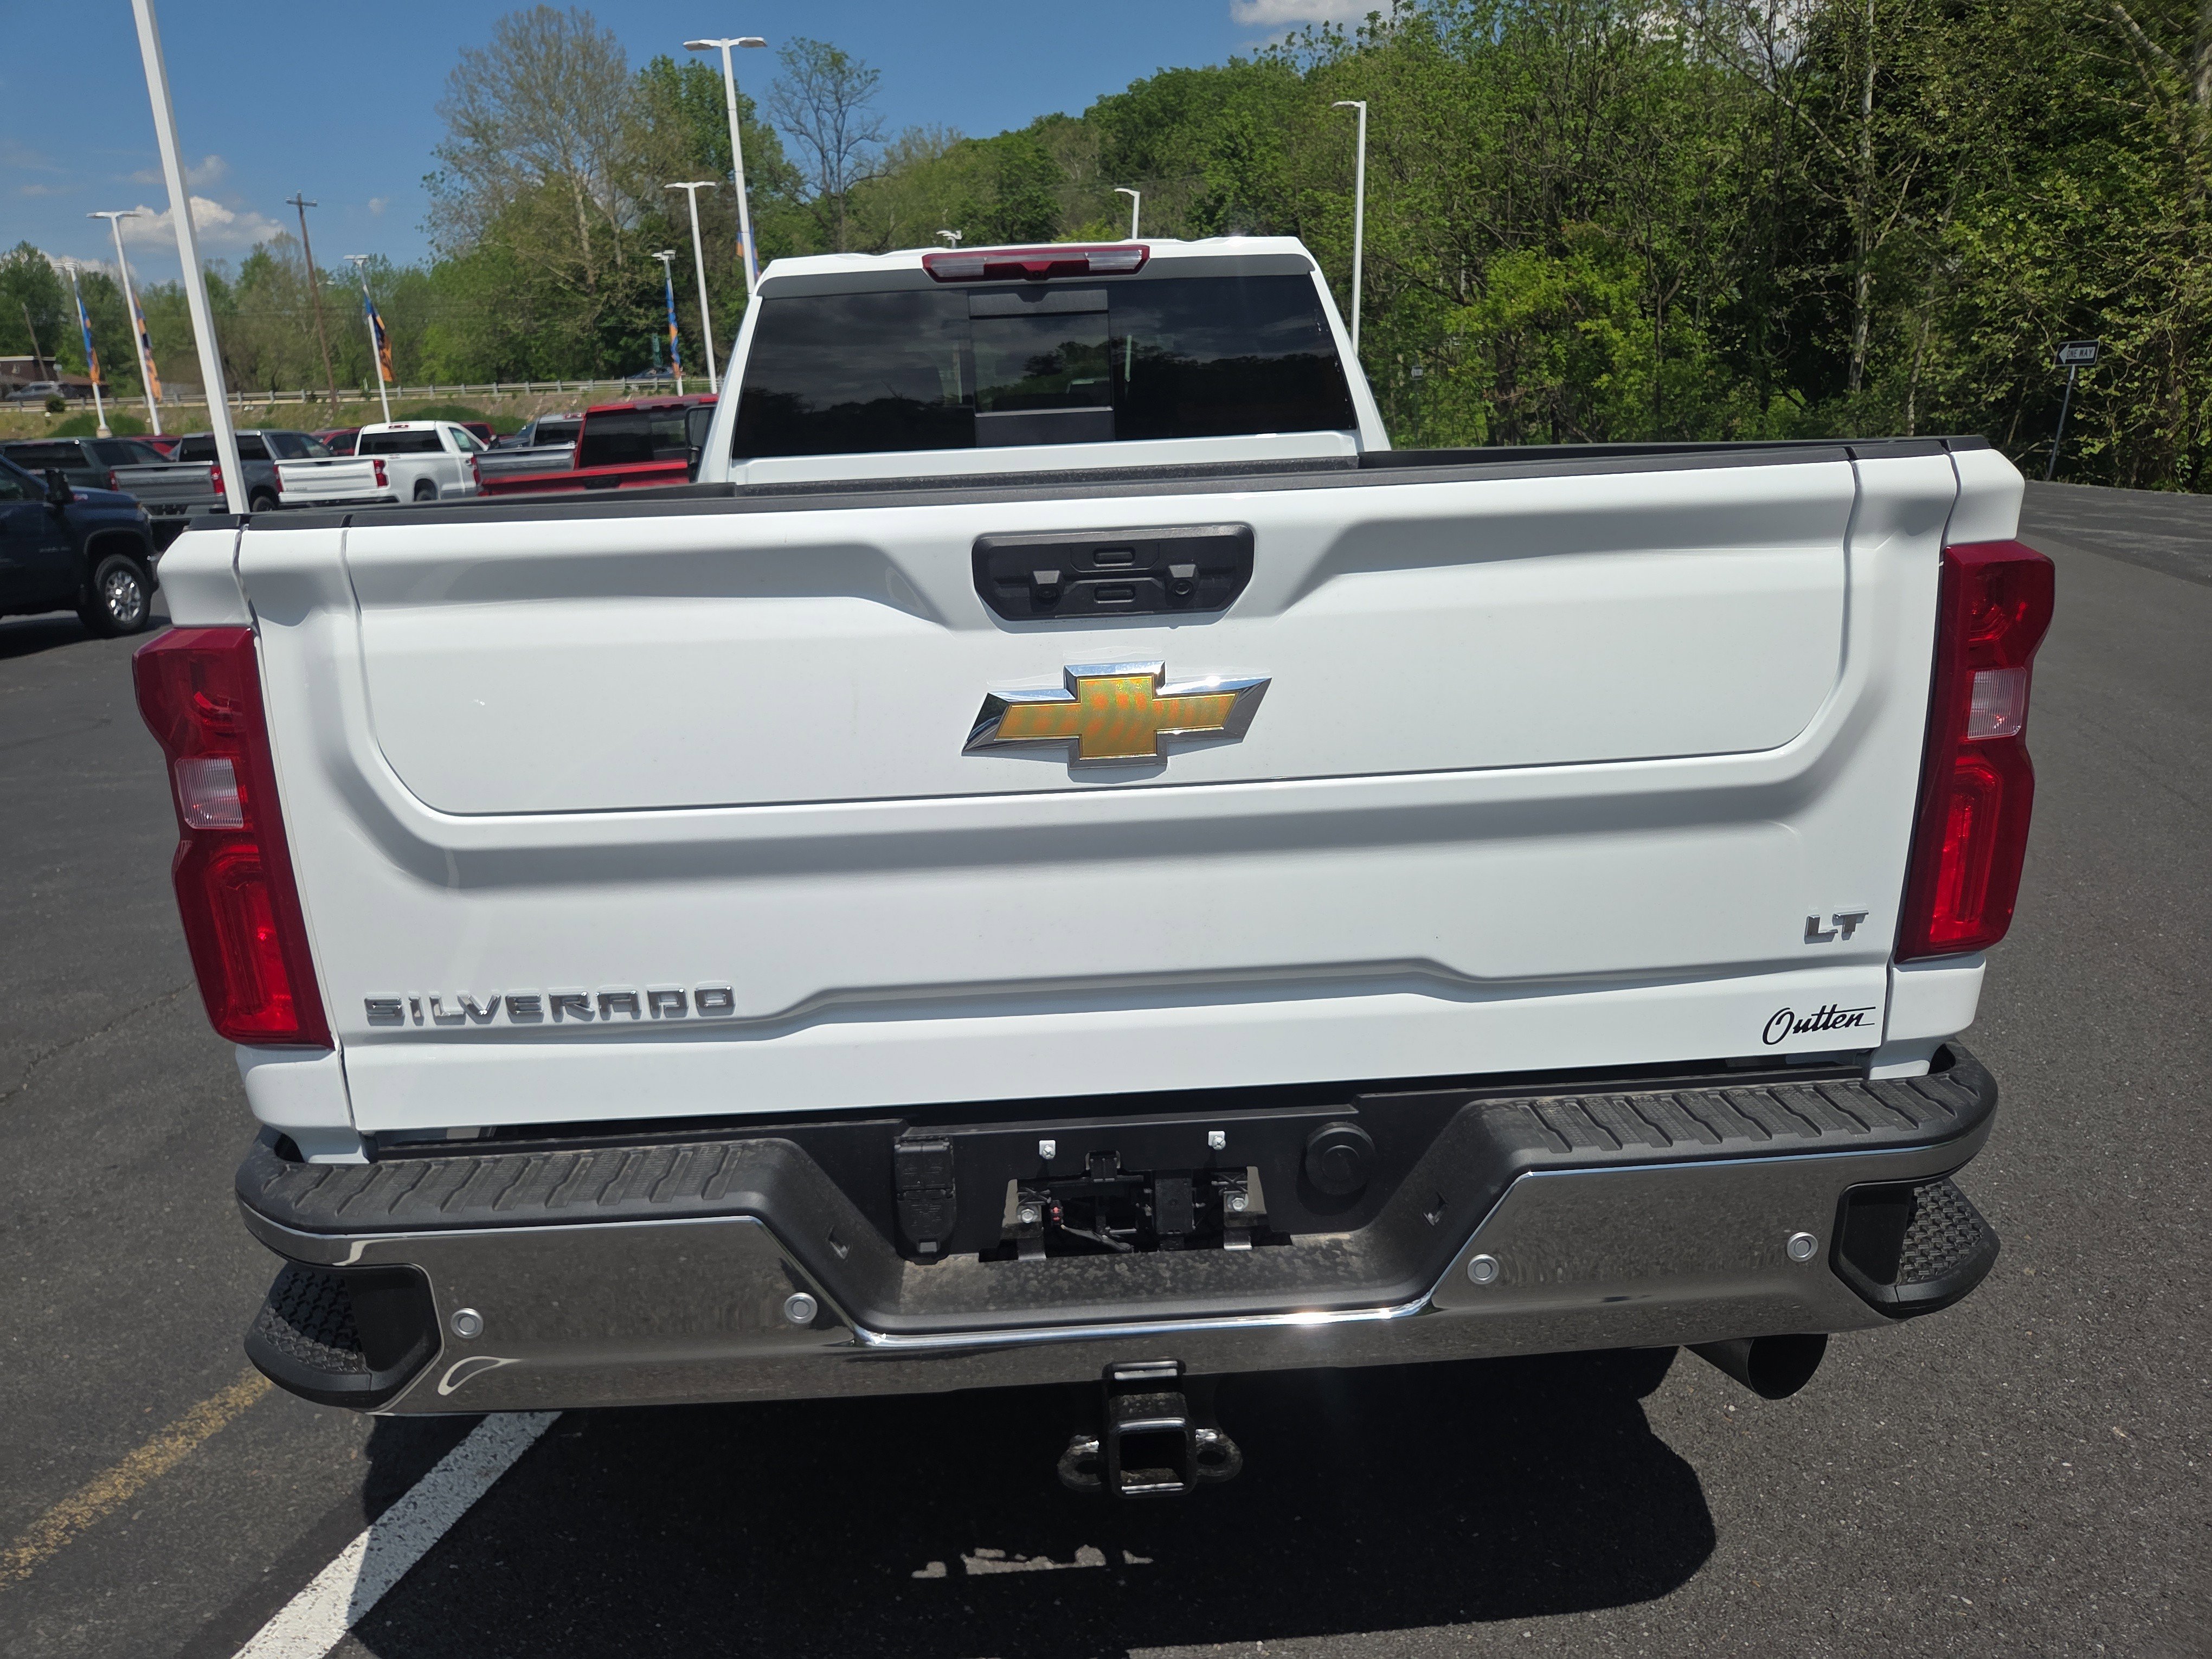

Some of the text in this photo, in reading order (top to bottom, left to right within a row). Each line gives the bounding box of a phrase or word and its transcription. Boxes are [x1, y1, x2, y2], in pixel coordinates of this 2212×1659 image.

[2067, 349, 2093, 358] ONE WAY
[1804, 909, 1869, 944] LT
[364, 982, 735, 1026] SILVERADO
[1762, 1004, 1876, 1045] Outten
